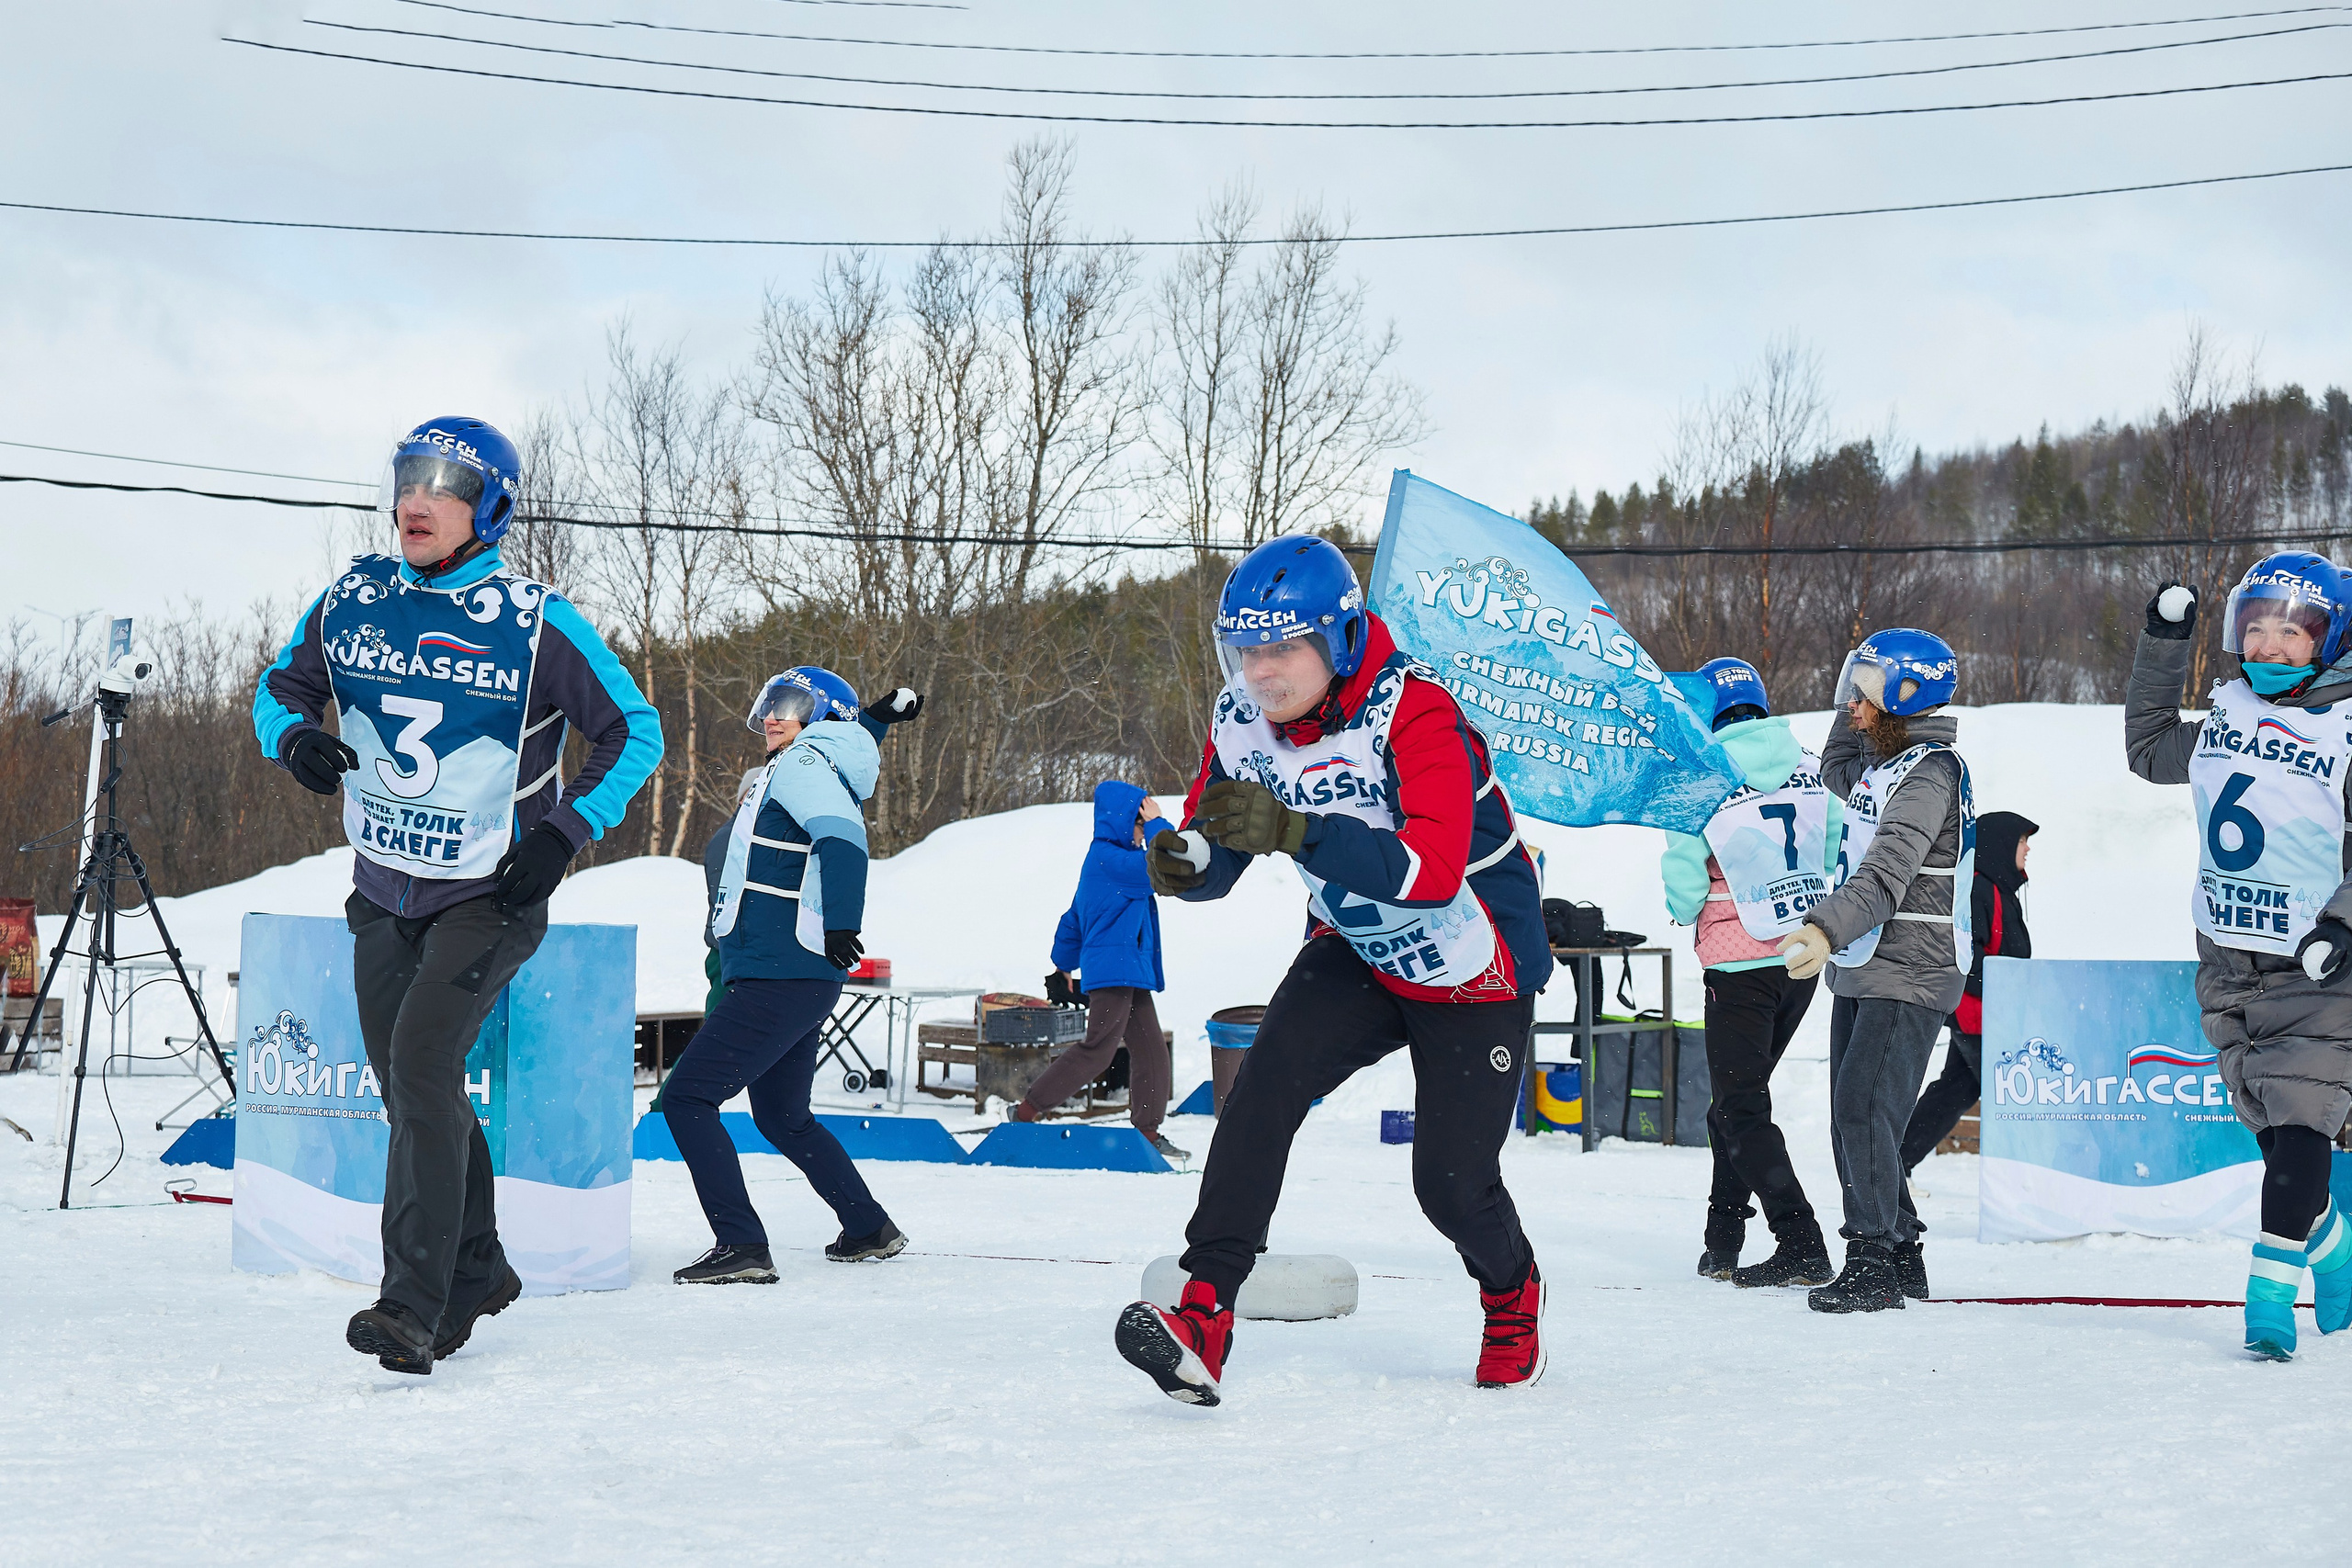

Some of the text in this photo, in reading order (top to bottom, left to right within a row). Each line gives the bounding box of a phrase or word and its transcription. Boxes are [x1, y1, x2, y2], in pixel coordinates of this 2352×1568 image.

[1281, 622, 1308, 634] ПЕРВЫЕ
[1288, 627, 1315, 639] РОССИИ
[377, 676, 401, 684] REGION
[465, 689, 517, 703] СНЕЖНЫЙ БОЙ
[1453, 650, 1658, 735] СНЕЖНЫЙ БОЙ
[375, 694, 444, 798] 3
[1492, 731, 1590, 775] RUSSIA
[400, 808, 466, 836] ТОЛК
[2207, 773, 2266, 873] 6
[361, 817, 462, 861] В СНЕГЕ
[1758, 803, 1797, 872] 7
[1770, 885, 1786, 896] ДЛЯ
[1770, 887, 1804, 902] КТО ЗНАЕТ
[2222, 883, 2290, 910] ТОЛК
[1773, 901, 1790, 919] В
[245, 1104, 279, 1115] РОССИЯ,
[280, 1106, 341, 1119] МУРМАНСКАЯ
[341, 1110, 382, 1121] ОБЛАСТЬ
[1995, 1112, 2034, 1122] РОССИЯ,
[2035, 1112, 2102, 1122] МУРМАНСКАЯ
[2104, 1113, 2147, 1122] ОБЛАСТЬ
[2185, 1112, 2234, 1122] СНЕЖНЫЙ
